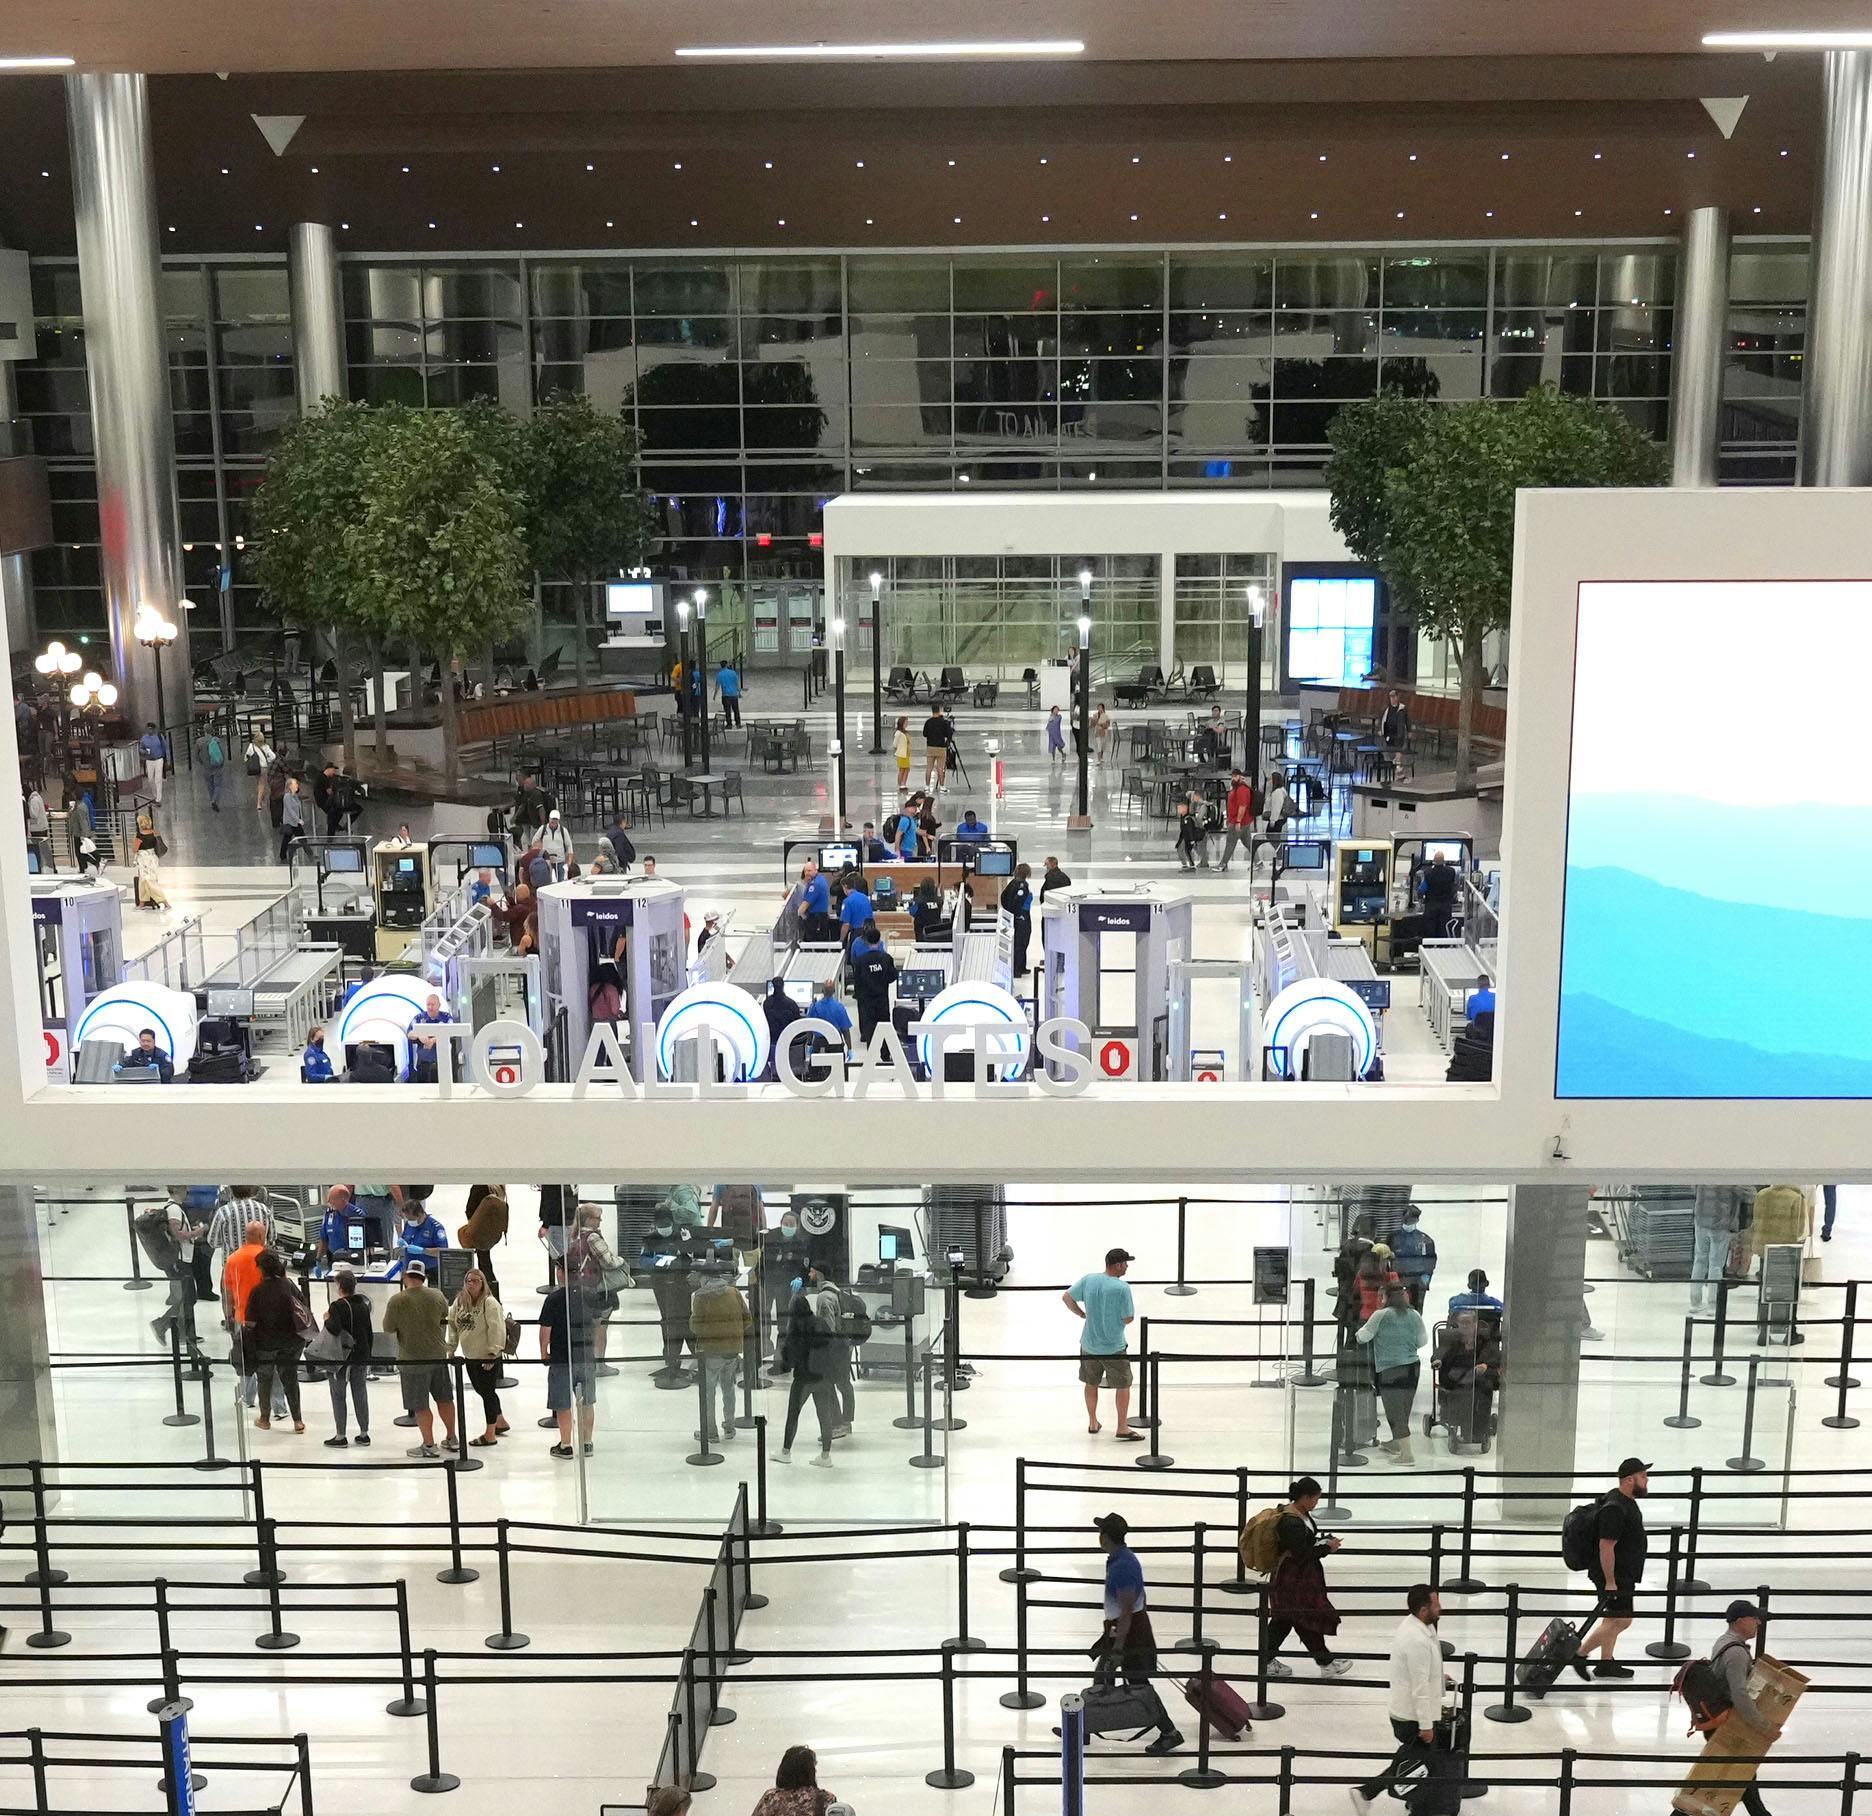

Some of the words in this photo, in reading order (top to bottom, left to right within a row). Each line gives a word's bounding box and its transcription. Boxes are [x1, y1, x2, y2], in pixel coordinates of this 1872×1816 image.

[64, 896, 75, 907] 10
[561, 899, 570, 909] 11
[636, 899, 647, 908] 12
[926, 902, 938, 910] TSA
[1067, 903, 1077, 914] 13
[595, 912, 619, 920] leidos
[1107, 917, 1130, 925] leidos
[868, 963, 883, 973] TSA
[412, 1020, 546, 1099] TO
[572, 1021, 749, 1099] ALL
[774, 1016, 1093, 1099] GATES
